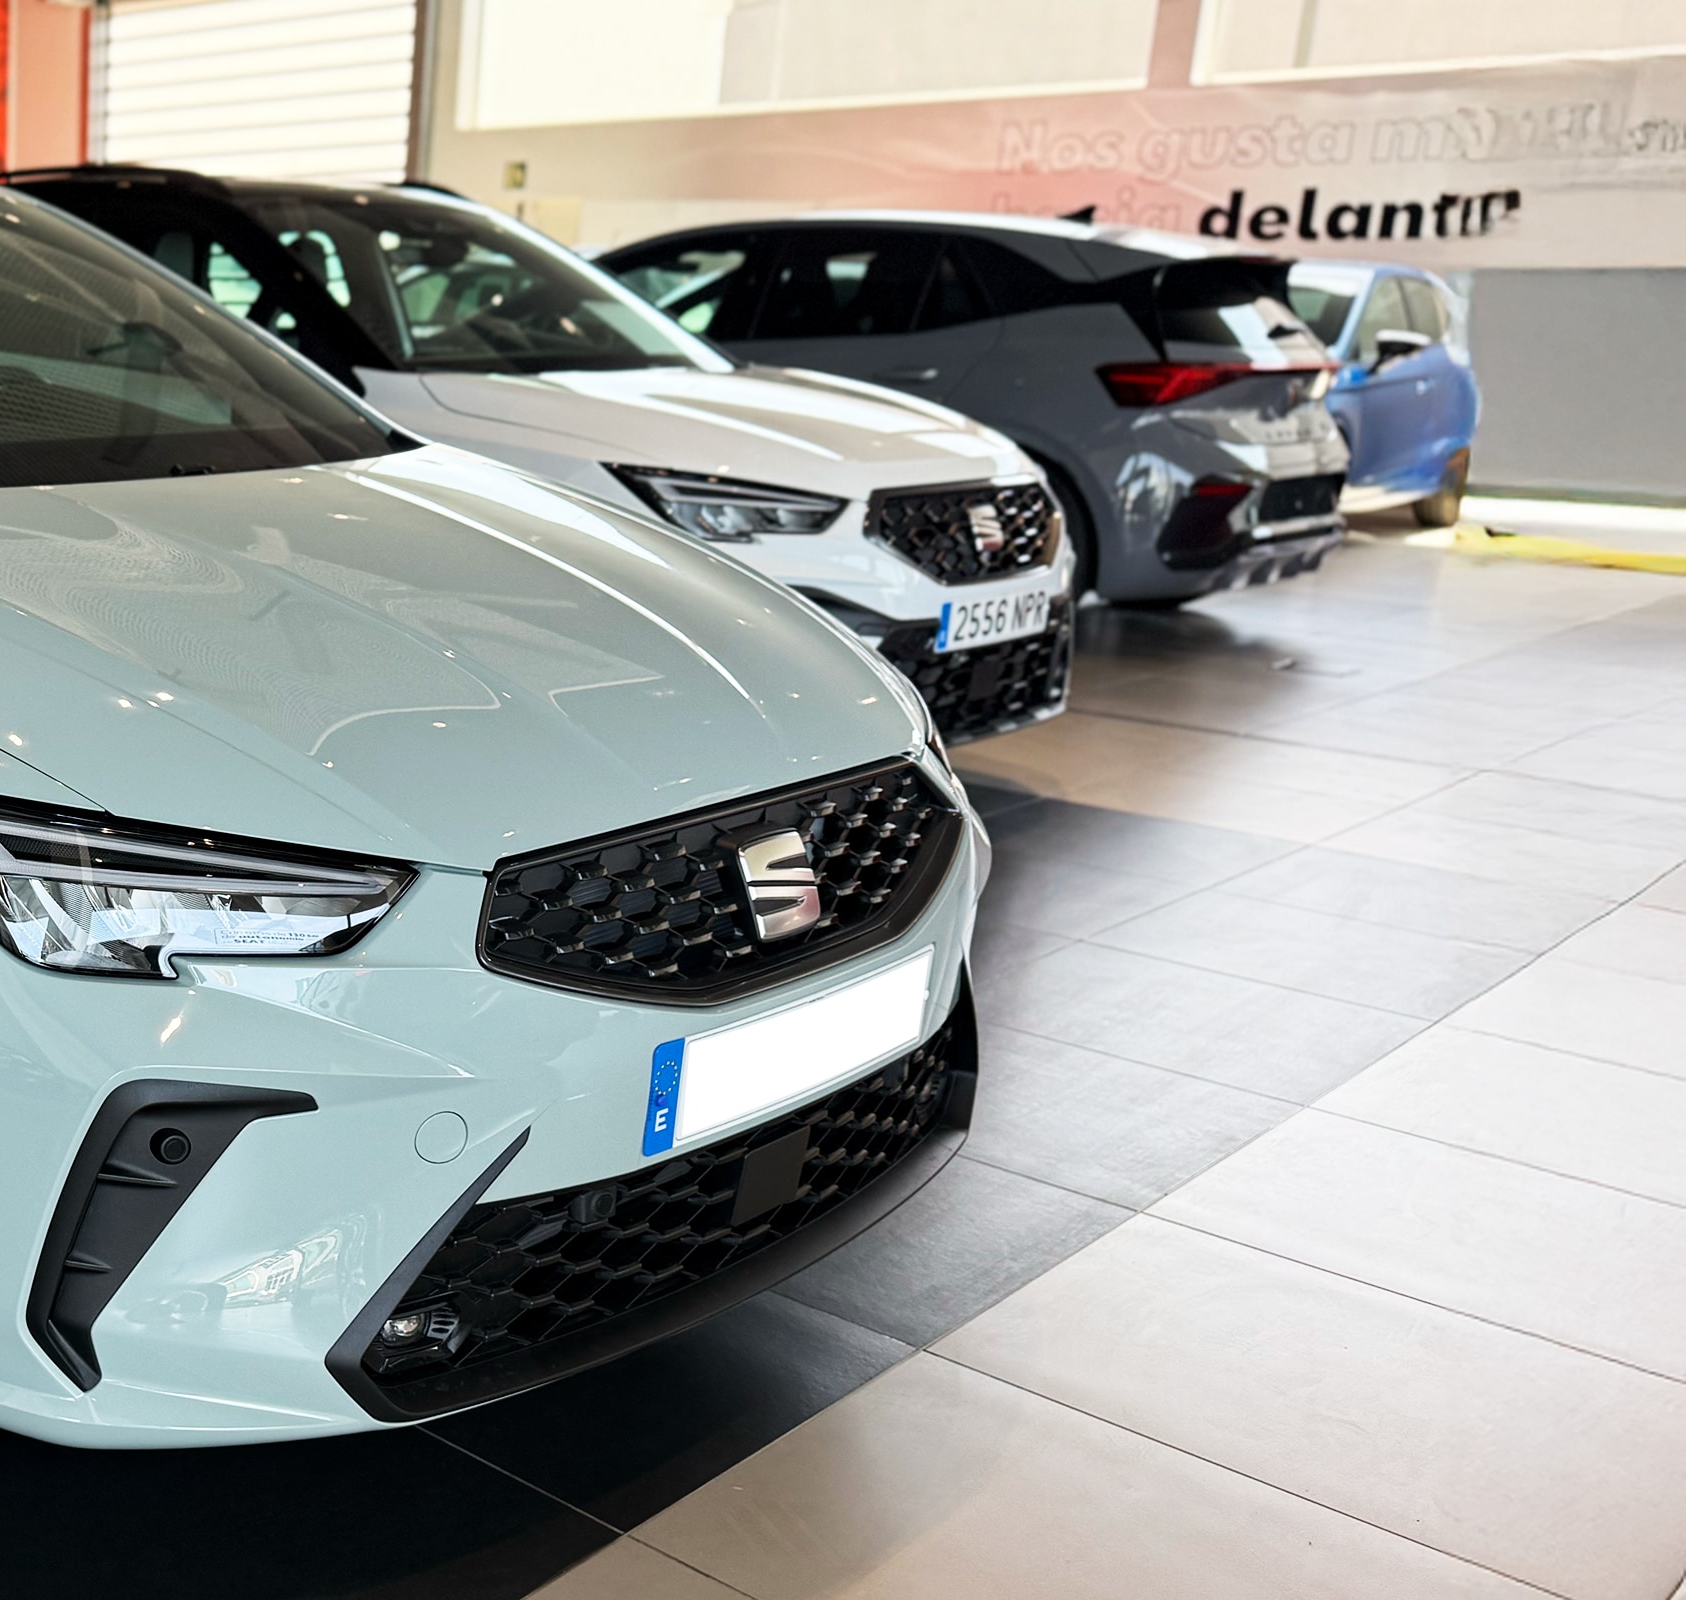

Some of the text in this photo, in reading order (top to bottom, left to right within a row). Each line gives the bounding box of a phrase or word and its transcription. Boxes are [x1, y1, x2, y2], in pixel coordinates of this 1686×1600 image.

[996, 118, 1125, 177] Nos
[1136, 112, 1355, 184] gusta
[954, 590, 1046, 641] 2556 NPR
[654, 1107, 669, 1132] E
